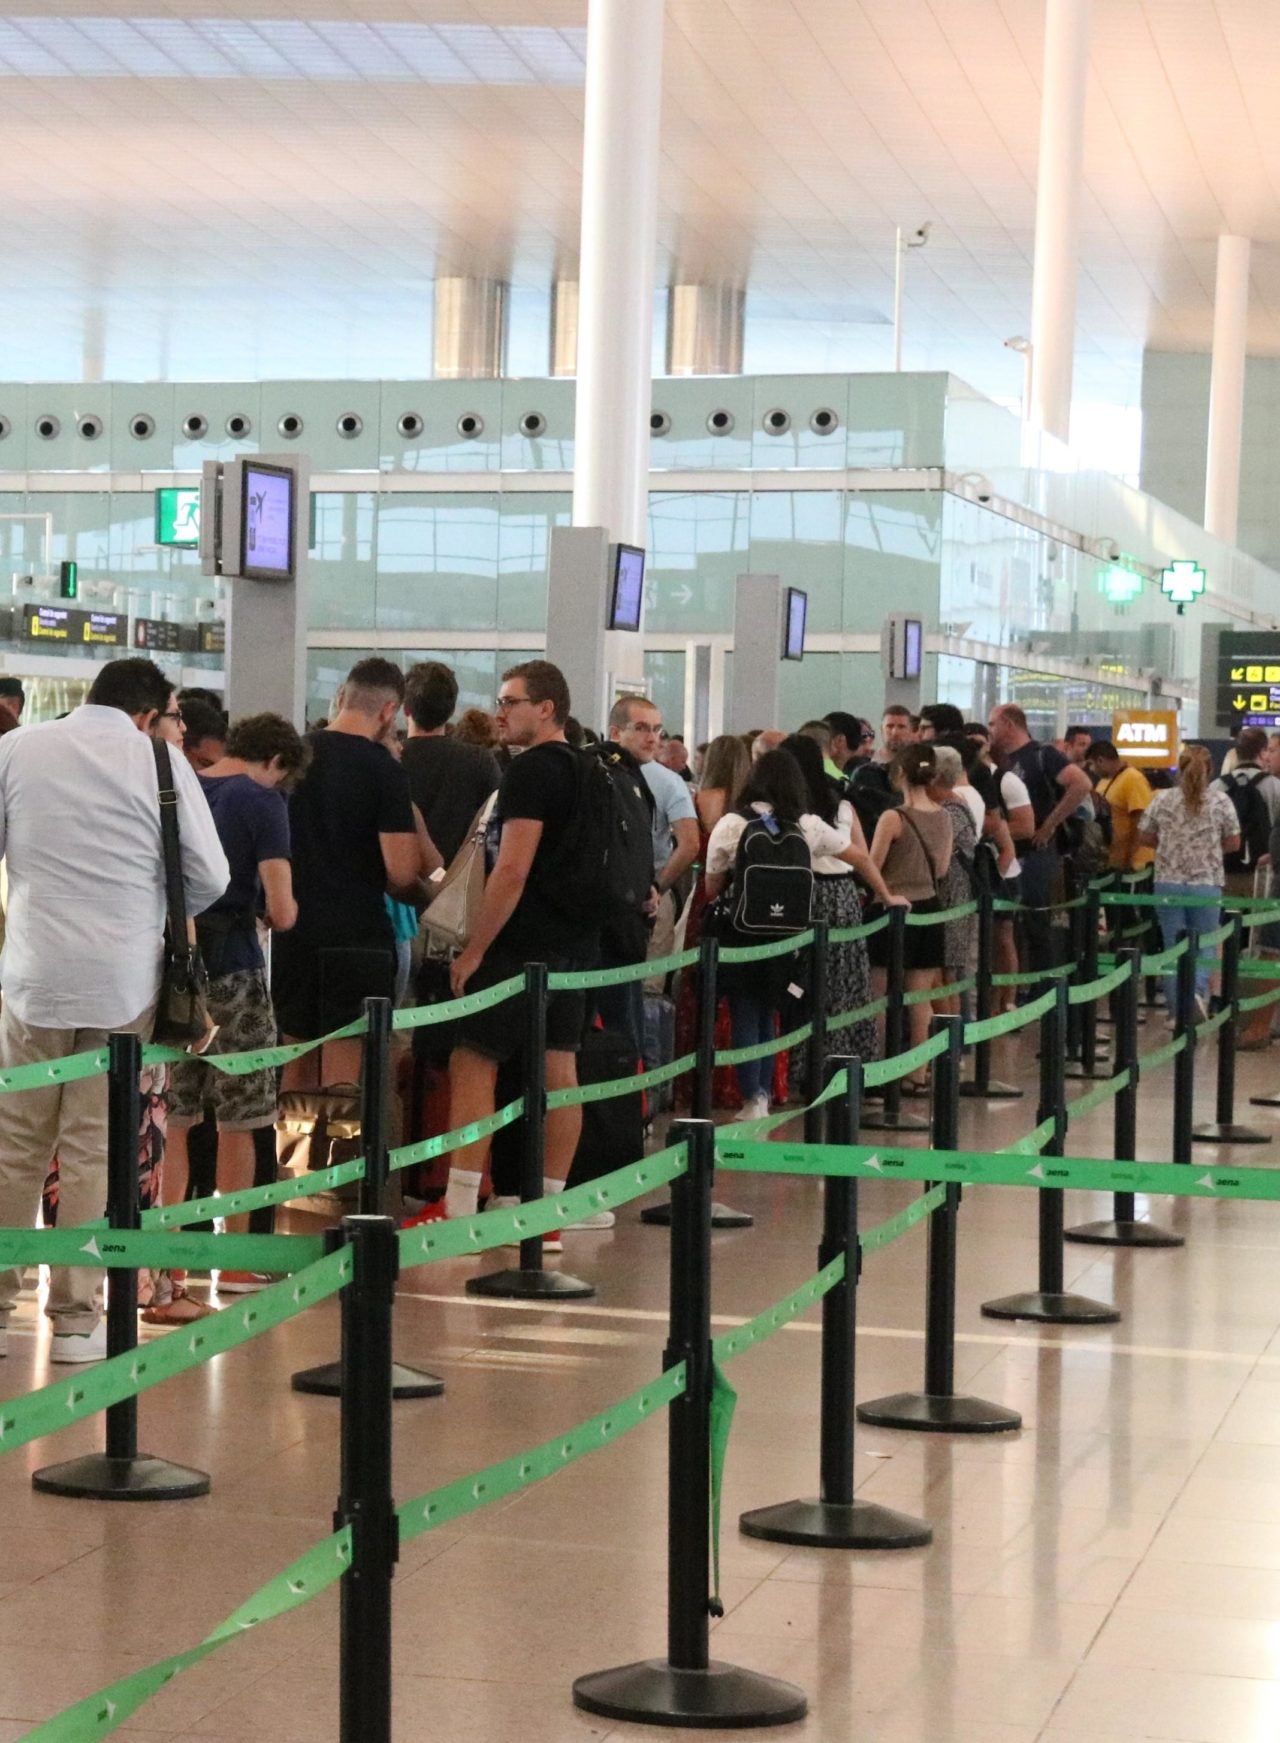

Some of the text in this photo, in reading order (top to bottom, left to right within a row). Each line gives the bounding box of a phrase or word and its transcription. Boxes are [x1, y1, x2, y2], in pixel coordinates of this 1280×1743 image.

[1116, 723, 1167, 742] ATM
[723, 1150, 744, 1160] aena
[882, 1158, 904, 1168] aena
[1046, 1168, 1069, 1177] aena
[1216, 1177, 1239, 1187] aena
[102, 1244, 126, 1253] aena
